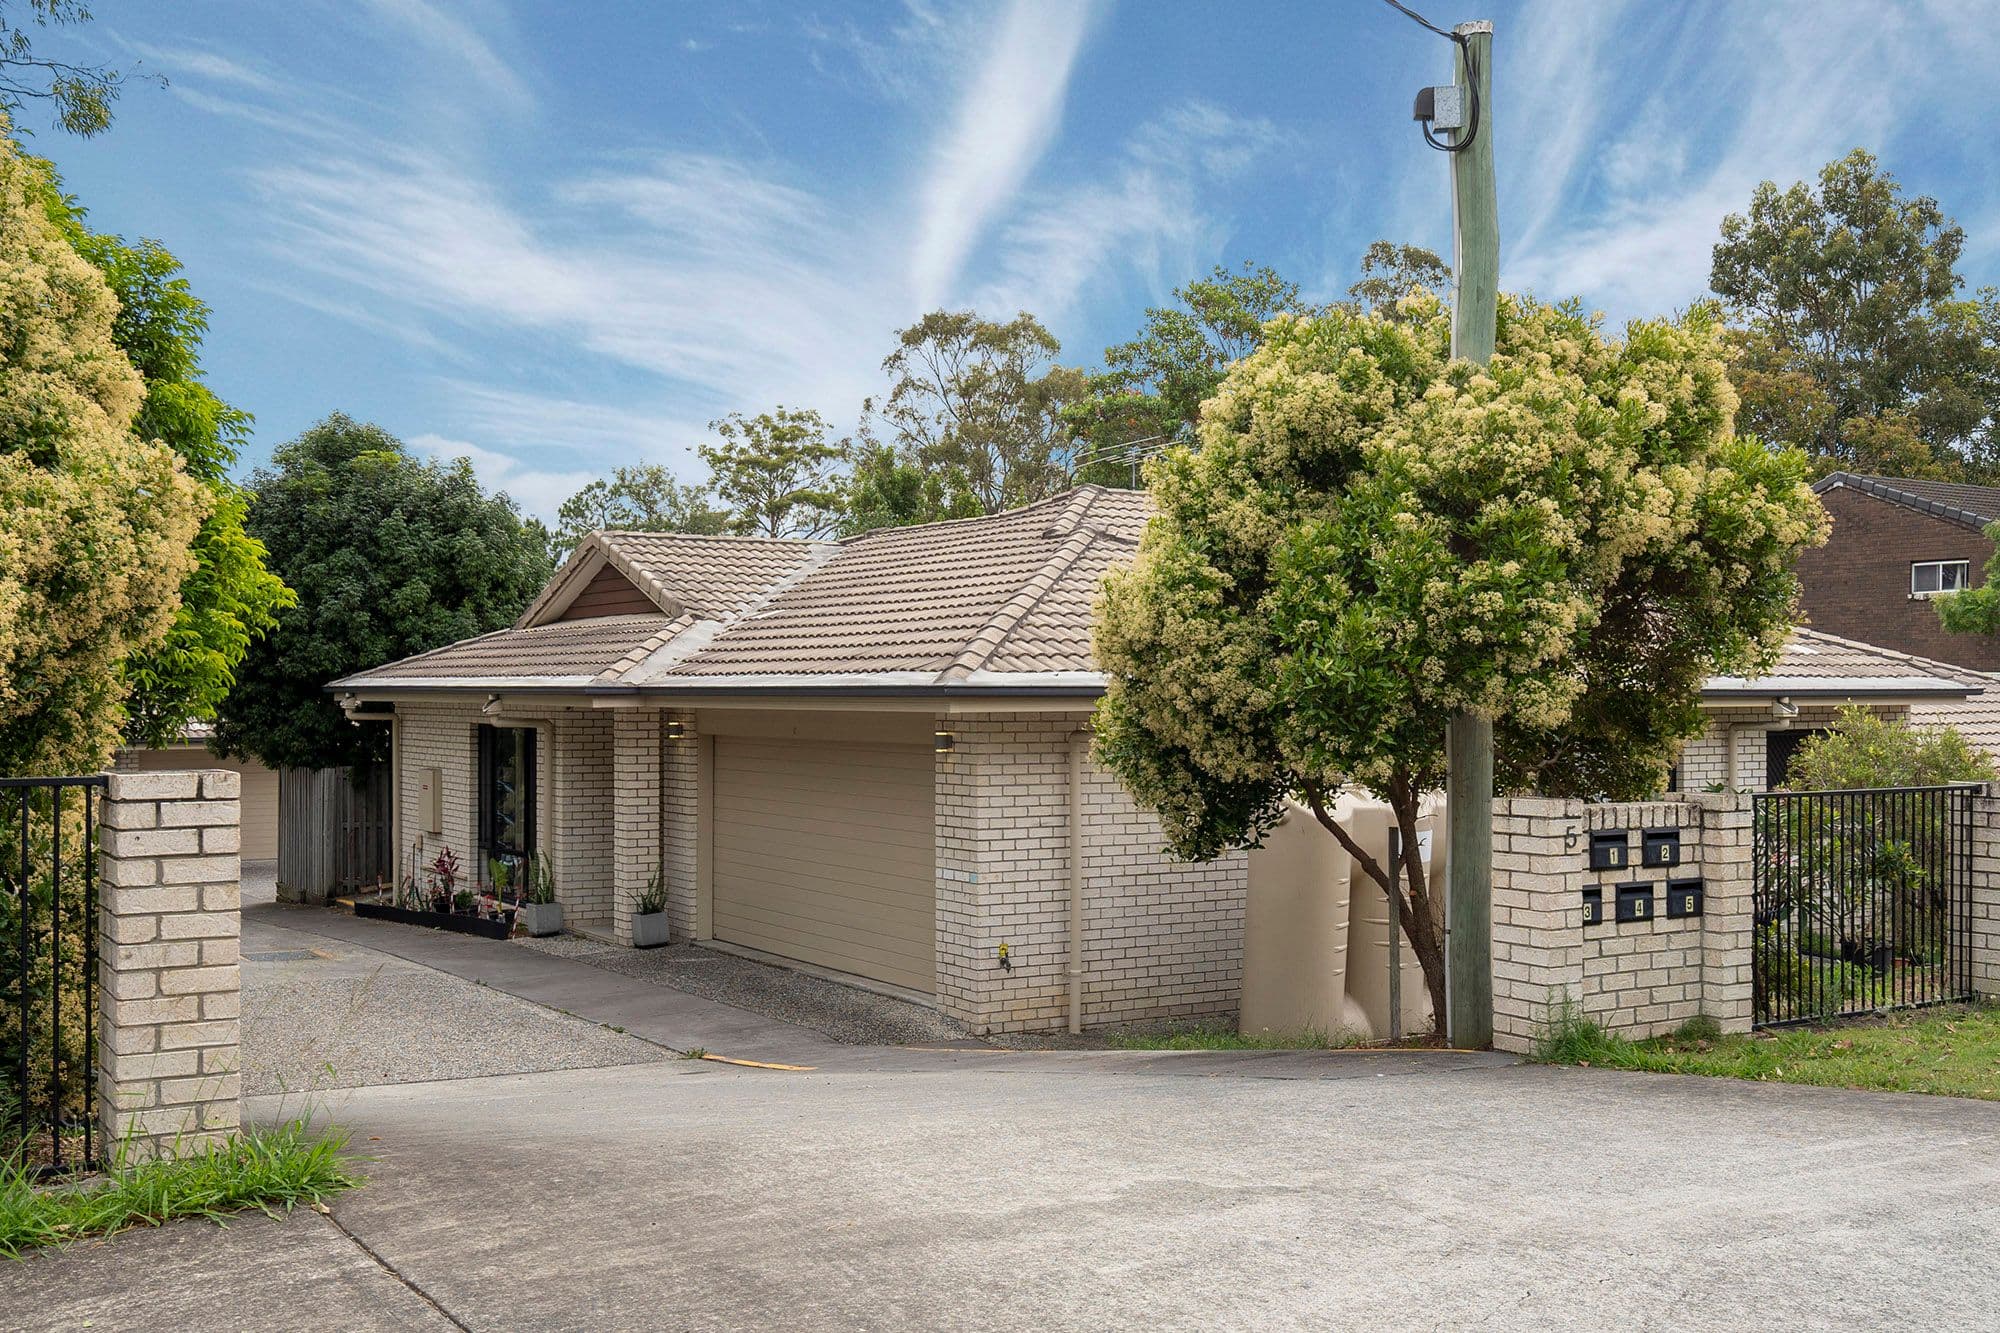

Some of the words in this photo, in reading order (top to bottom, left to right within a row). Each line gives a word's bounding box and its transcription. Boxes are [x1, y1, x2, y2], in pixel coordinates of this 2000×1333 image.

[1565, 825, 1577, 848] 5
[1662, 847, 1669, 859] 2
[1636, 901, 1642, 914] 4
[1686, 898, 1693, 910] 5
[1584, 905, 1591, 918] 3
